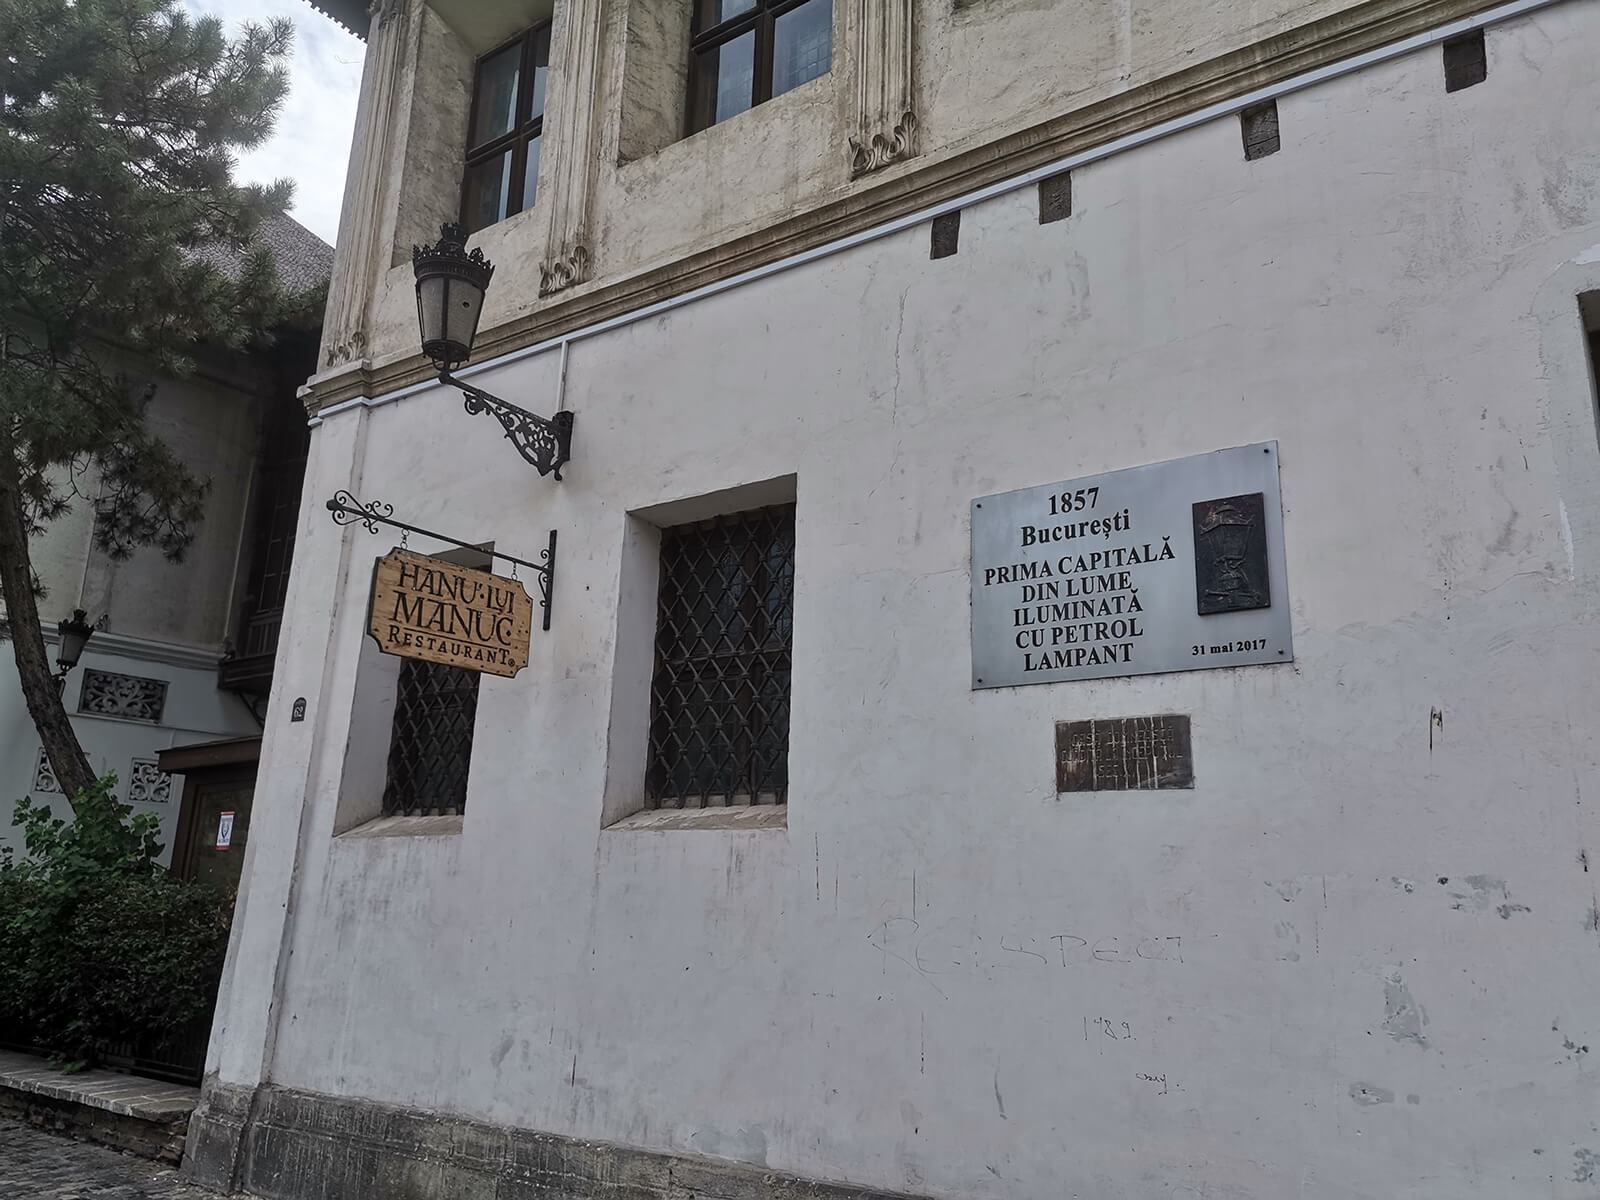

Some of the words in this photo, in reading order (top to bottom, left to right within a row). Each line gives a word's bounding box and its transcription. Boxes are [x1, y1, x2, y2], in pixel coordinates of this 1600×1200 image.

[1049, 487, 1099, 515] 1857
[1021, 509, 1131, 547] București
[984, 560, 1053, 586] PRIMA
[1058, 536, 1175, 574] CAPITALĂ
[1022, 581, 1059, 603] DIN
[1066, 571, 1132, 597] LUME
[389, 590, 514, 646] MANUC
[1013, 588, 1143, 626] ILUMINATĂ
[387, 624, 510, 666] RESTAURANT
[1016, 629, 1044, 649] CU
[1051, 618, 1143, 645] PETROL
[1192, 645, 1205, 656] 31
[1210, 642, 1233, 654] mai
[1236, 639, 1266, 652] 2017
[1024, 643, 1134, 672] LAMPANT
